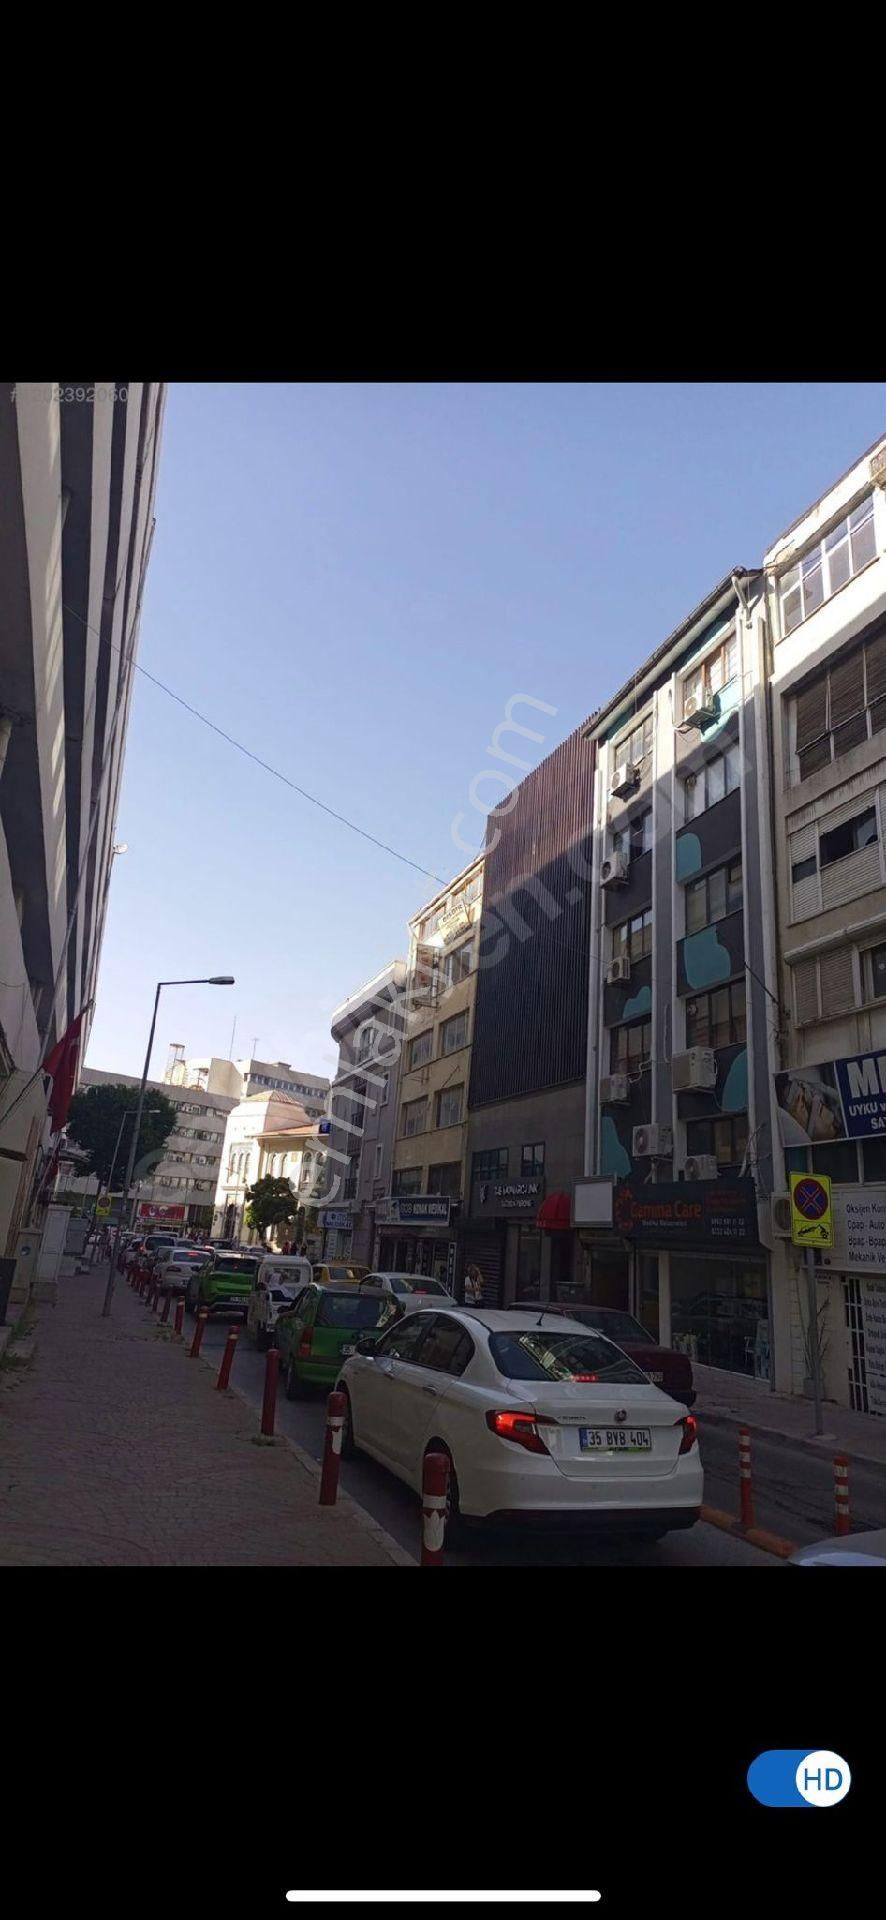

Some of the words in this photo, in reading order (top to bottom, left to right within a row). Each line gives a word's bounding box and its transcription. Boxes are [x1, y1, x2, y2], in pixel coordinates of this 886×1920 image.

[848, 1102, 878, 1117] UYKU
[673, 1200, 702, 1218] Care
[848, 1251, 876, 1263] Mekanik
[588, 1431, 601, 1446] 35
[630, 1431, 648, 1446] 404
